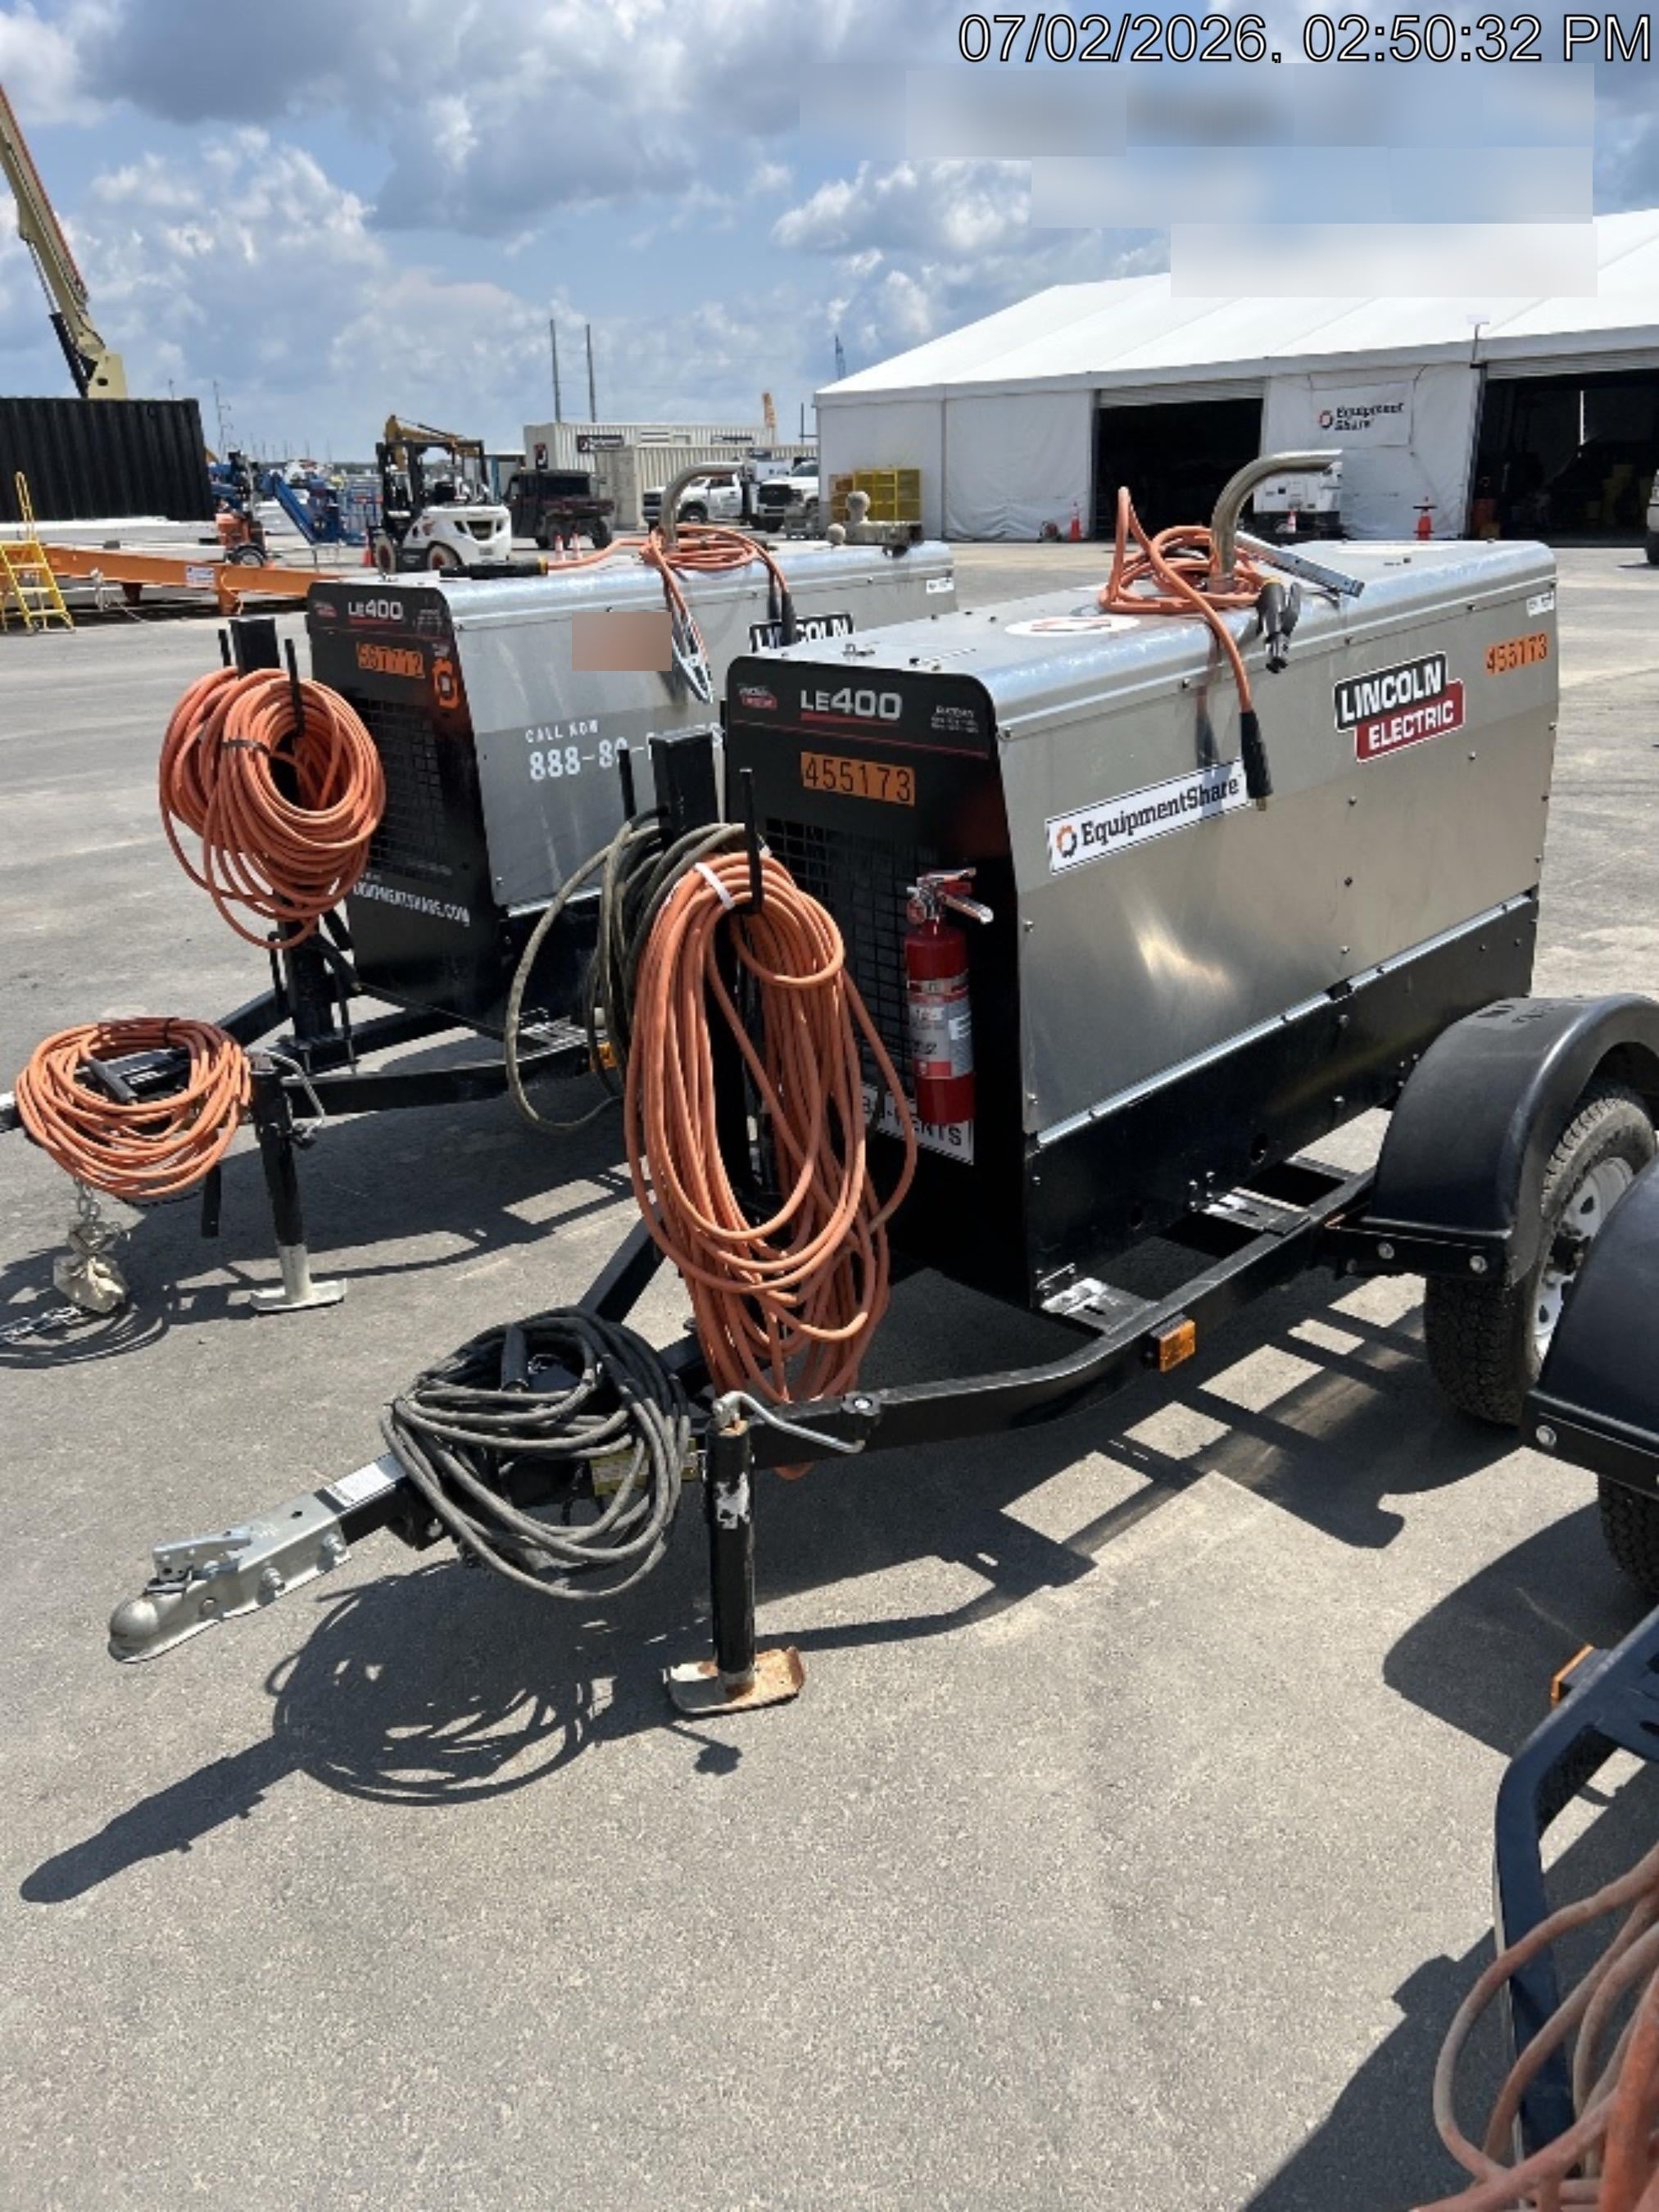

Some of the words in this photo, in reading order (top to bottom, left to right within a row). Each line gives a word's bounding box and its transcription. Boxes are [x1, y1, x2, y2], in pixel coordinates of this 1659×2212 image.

[347, 599, 404, 620] LE400
[1486, 633, 1547, 673] 455173
[800, 687, 902, 721] LE400
[1340, 660, 1442, 723] LINCOLN
[525, 723, 564, 742] CALL
[1368, 700, 1454, 750] ELECTRIC
[805, 755, 911, 802] 455173
[1081, 777, 1240, 846] EquipmentShare
